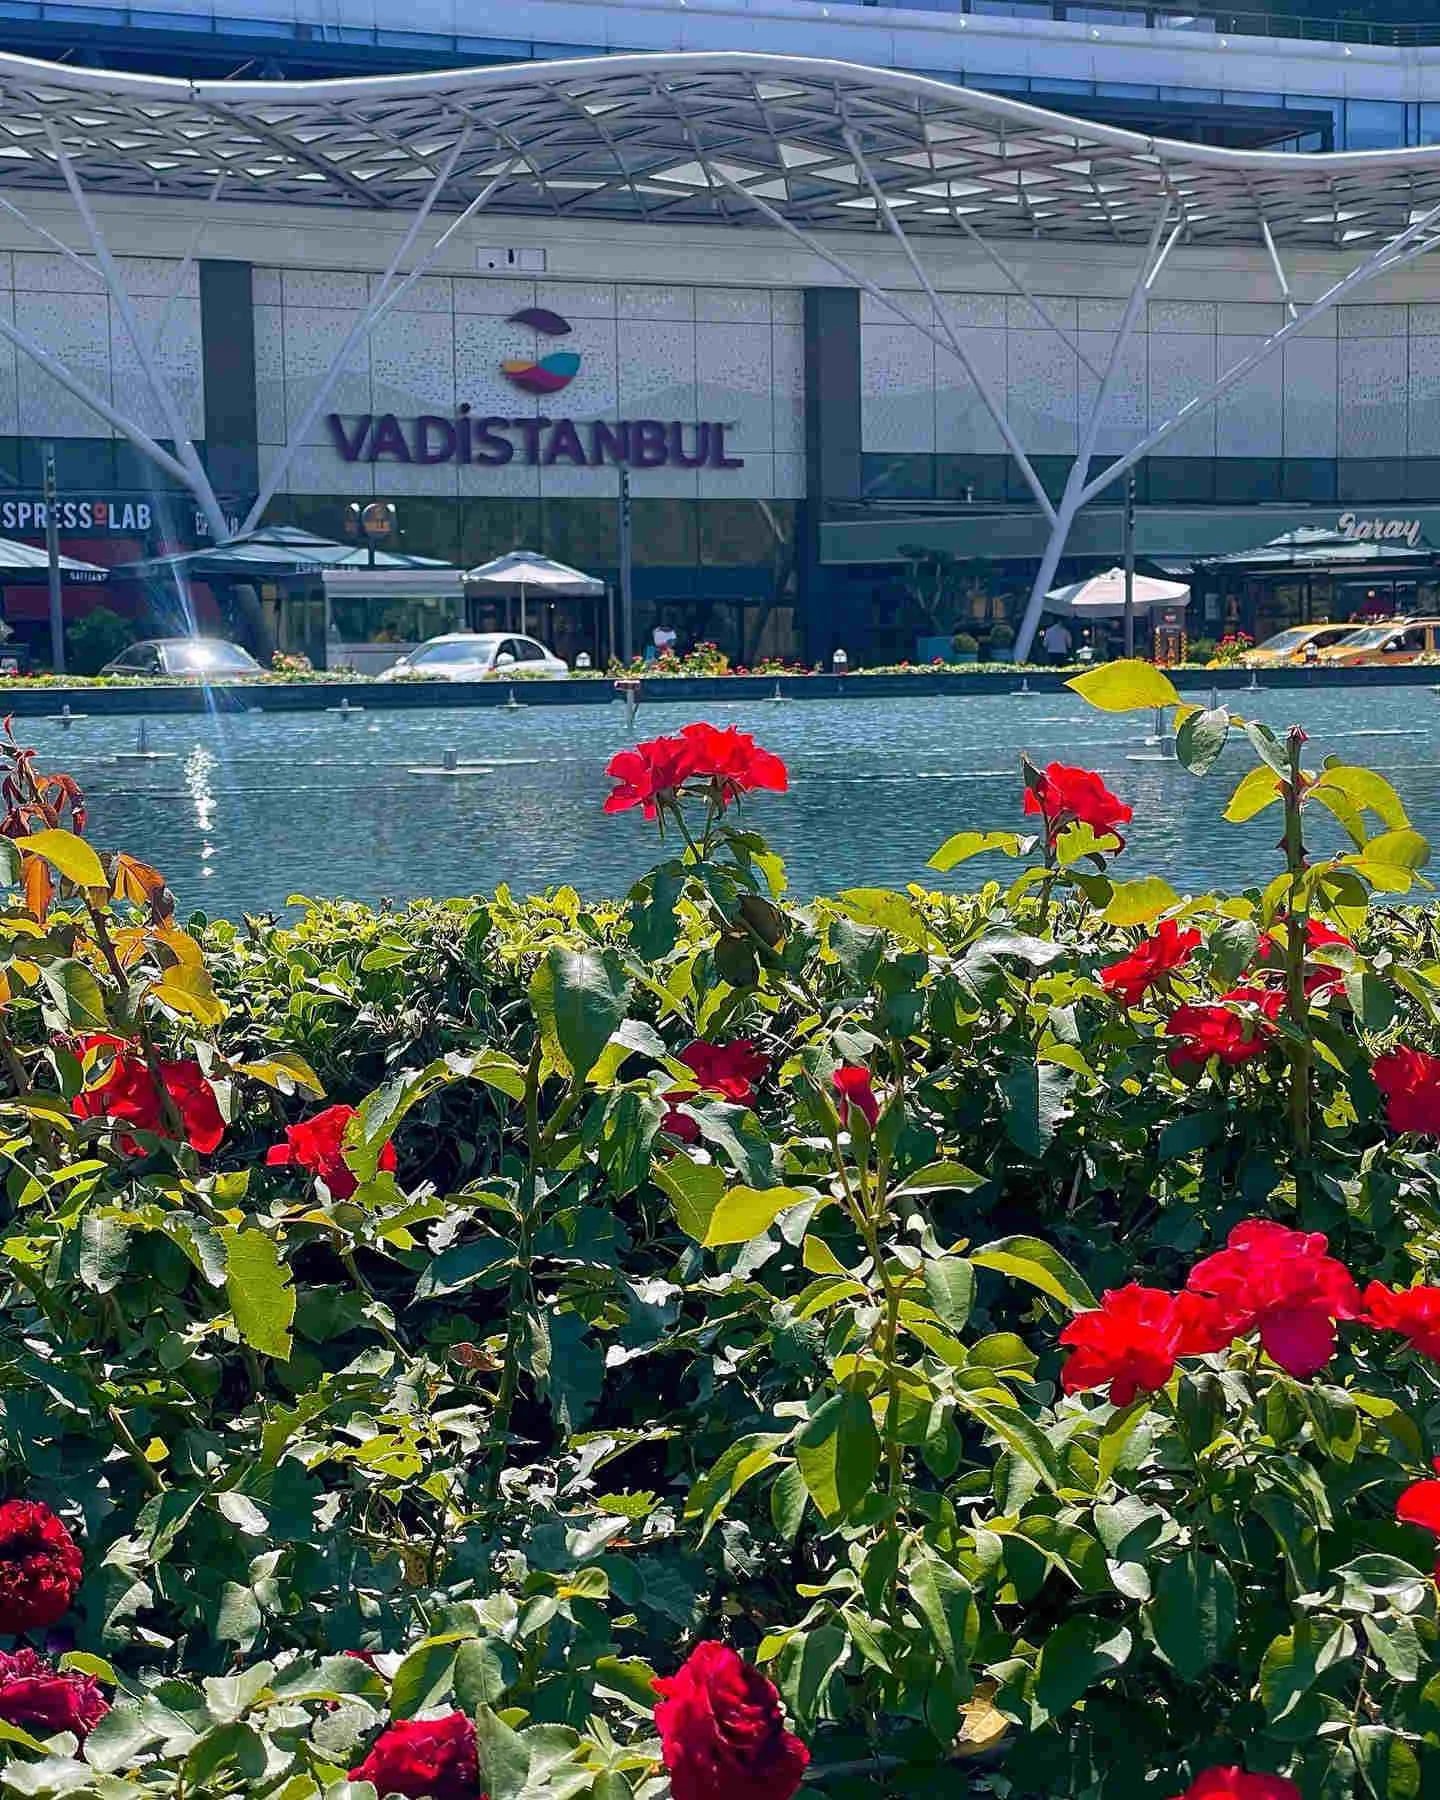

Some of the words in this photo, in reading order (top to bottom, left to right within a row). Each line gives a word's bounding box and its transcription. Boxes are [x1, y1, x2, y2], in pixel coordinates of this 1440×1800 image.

[328, 402, 744, 468] VADİSTANBUL
[0, 501, 152, 530] SPRESSOLAB
[1338, 511, 1421, 548] Saray
